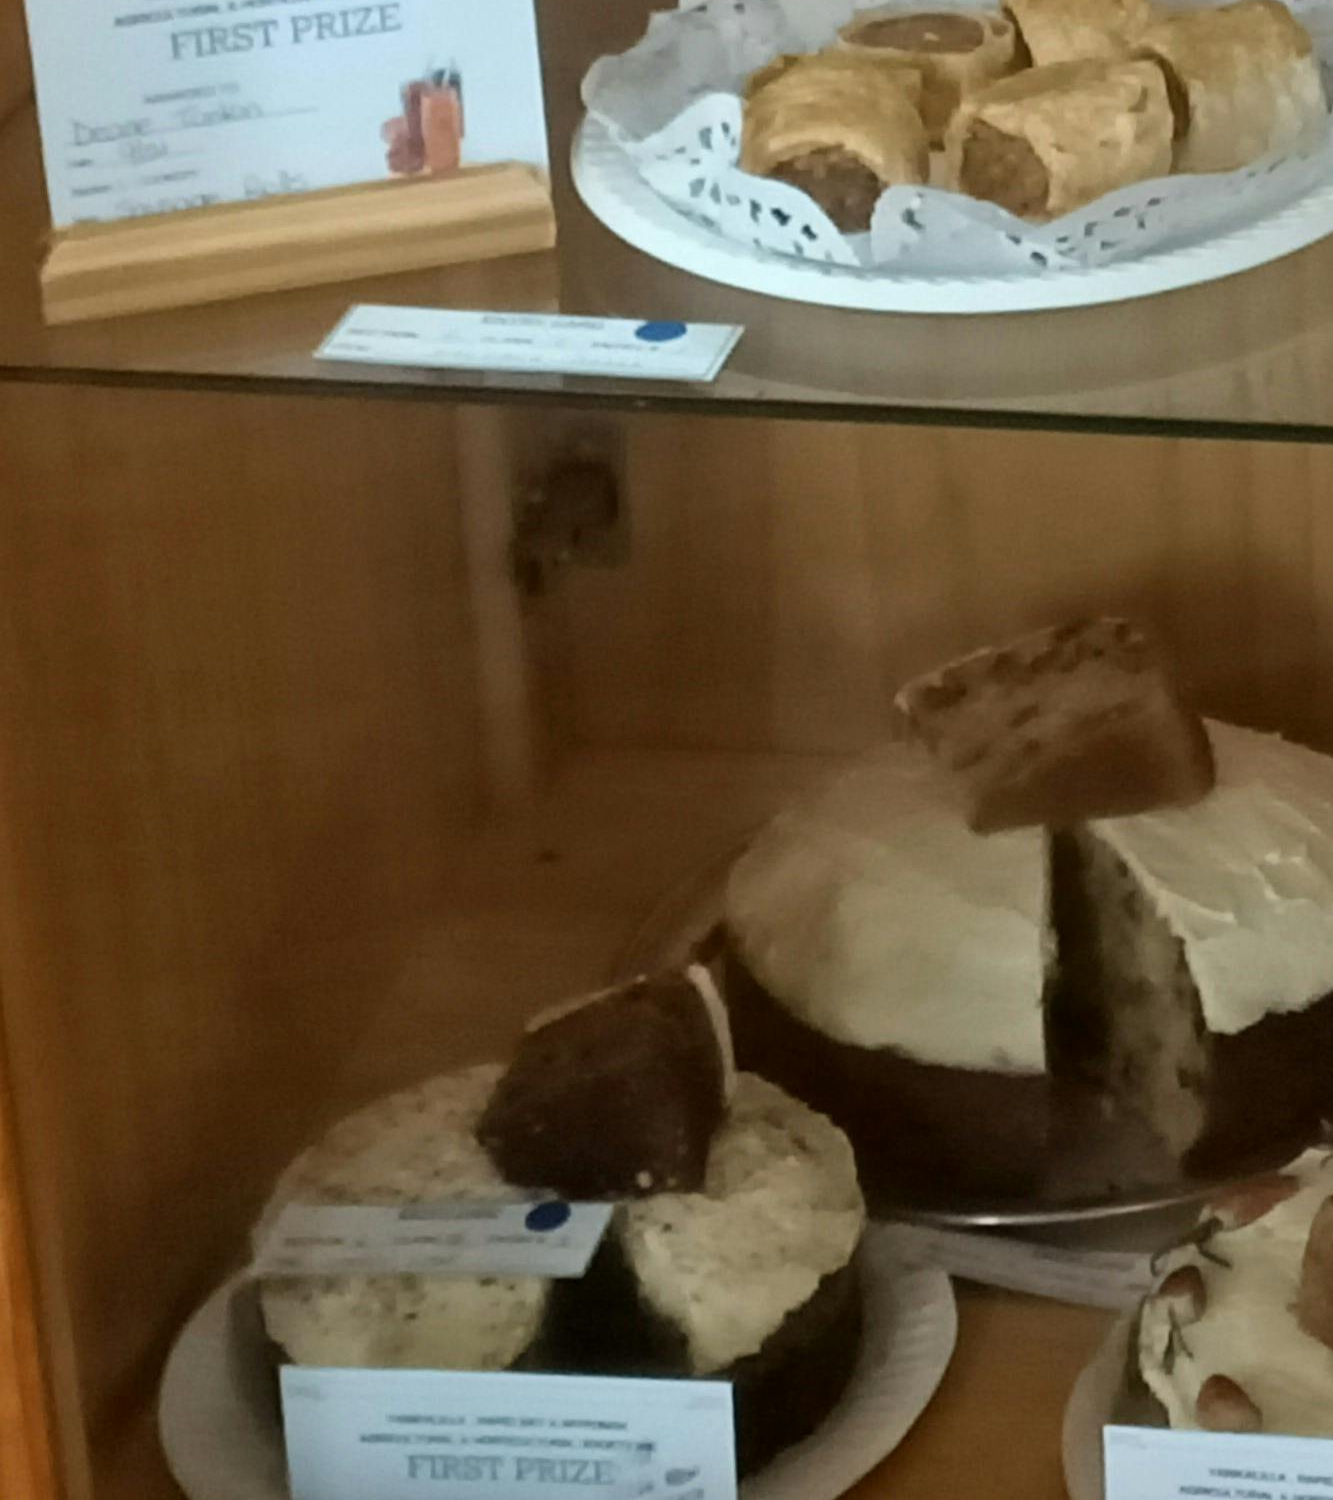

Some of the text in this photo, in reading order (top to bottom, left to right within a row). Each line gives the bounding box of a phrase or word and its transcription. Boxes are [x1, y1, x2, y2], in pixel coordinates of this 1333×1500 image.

[171, 4, 402, 60] FIRST PRIZE
[408, 1455, 615, 1485] FIRST PRIZE
